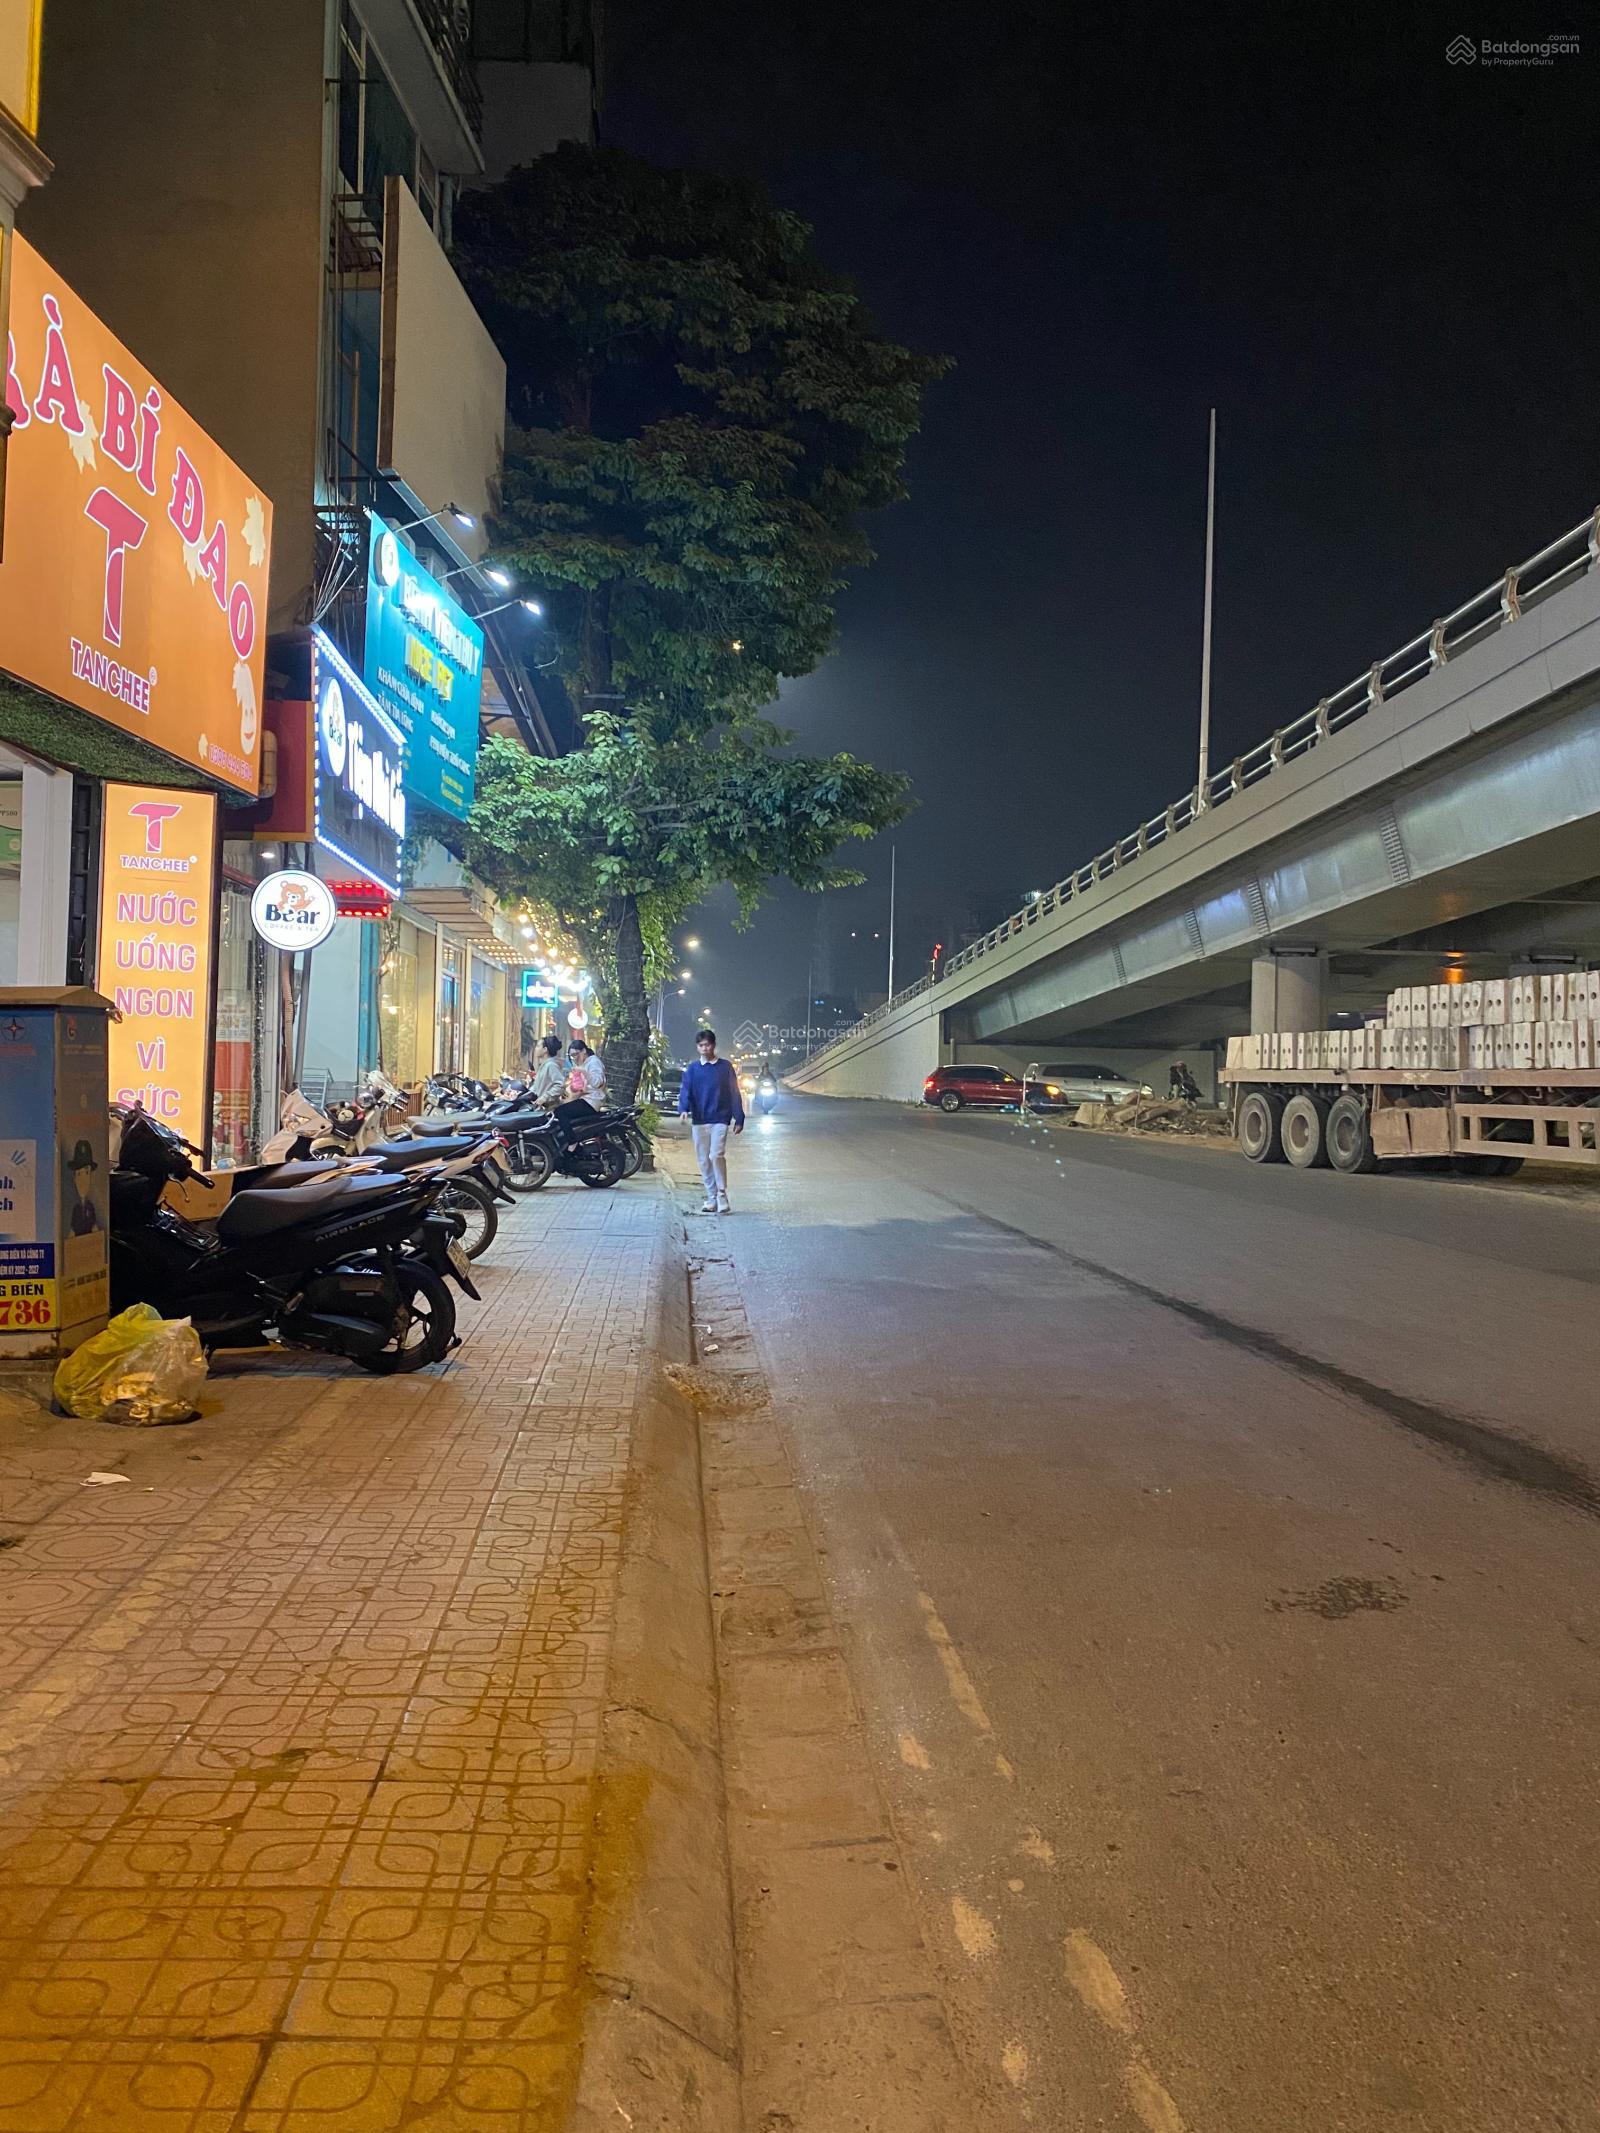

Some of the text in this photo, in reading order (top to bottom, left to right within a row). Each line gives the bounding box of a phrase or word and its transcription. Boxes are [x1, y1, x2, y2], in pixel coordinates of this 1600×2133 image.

[100, 363, 161, 496] BÍ
[168, 447, 255, 659] ĐAO
[70, 636, 151, 715] TANCHEE
[119, 854, 190, 874] TANCHEE
[116, 890, 198, 927] NƯỚC
[265, 903, 320, 925] Bear
[116, 934, 196, 972] UỐNG
[114, 986, 195, 1019] NGON
[136, 1036, 166, 1072] VÌ
[116, 1082, 181, 1118] SỨC
[11, 1281, 44, 1296] BIÊN
